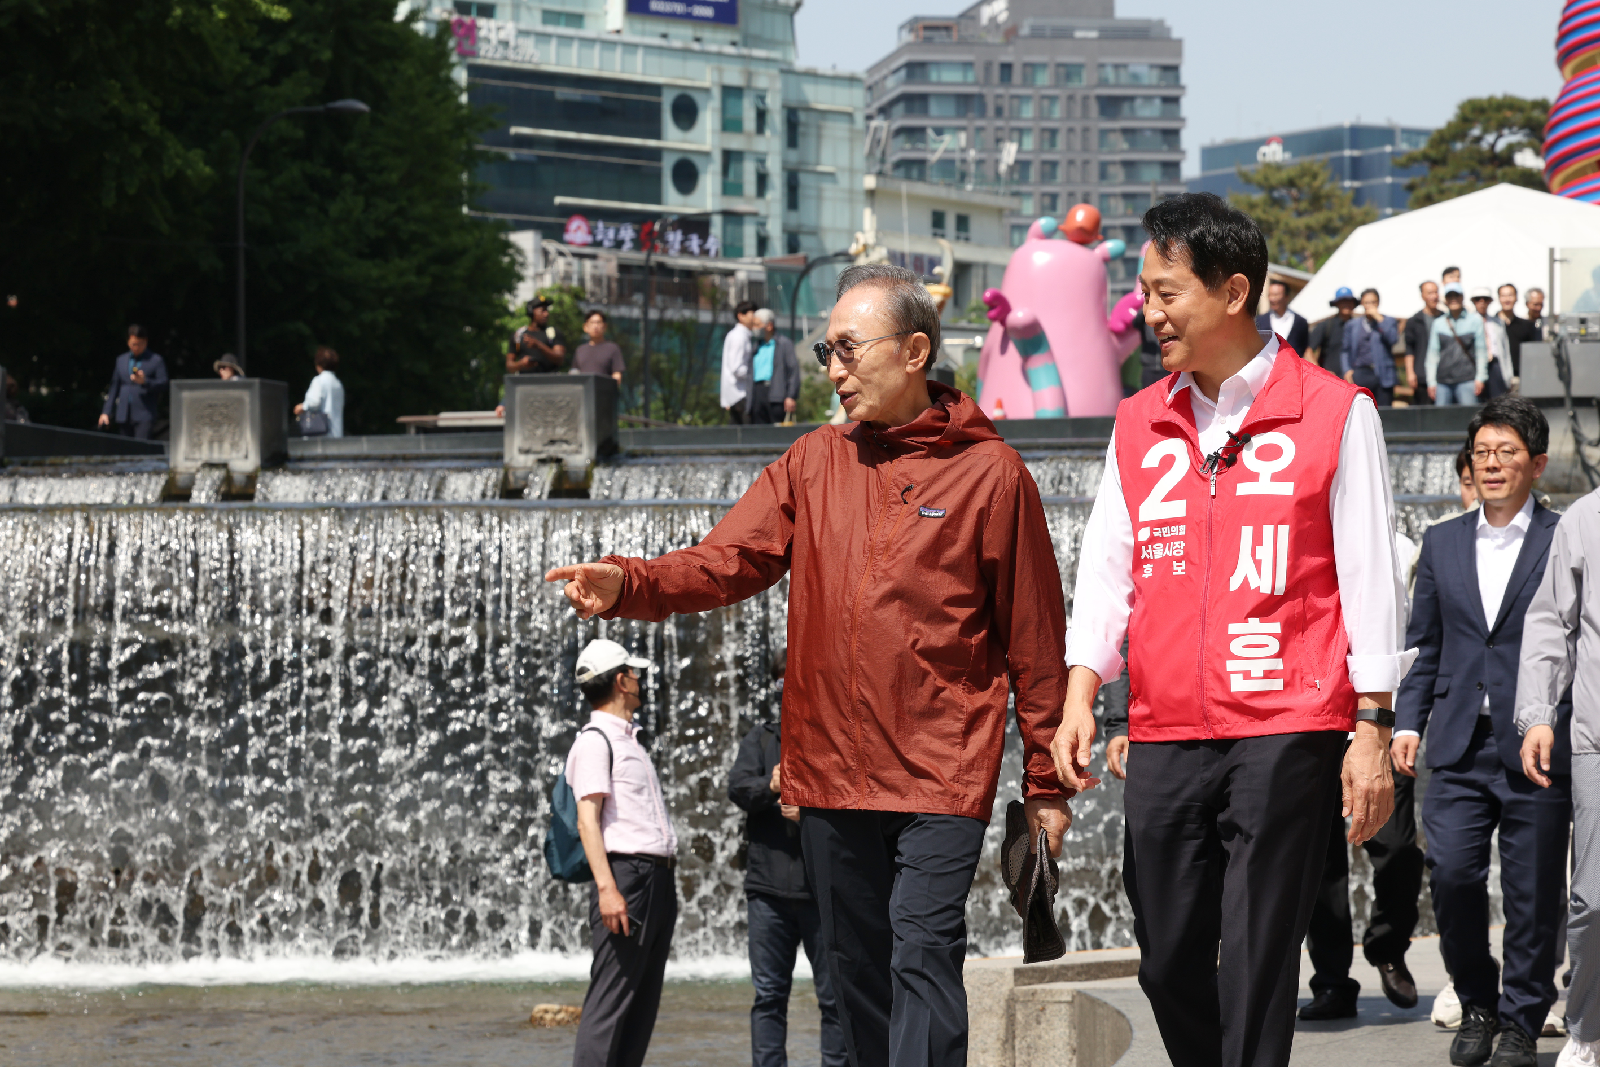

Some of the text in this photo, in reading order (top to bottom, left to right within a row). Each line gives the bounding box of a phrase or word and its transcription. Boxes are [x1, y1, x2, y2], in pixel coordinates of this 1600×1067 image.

[1138, 438, 1191, 523] 2
[1141, 541, 1186, 560] 서울시장
[1226, 431, 1296, 693] 오세훈
